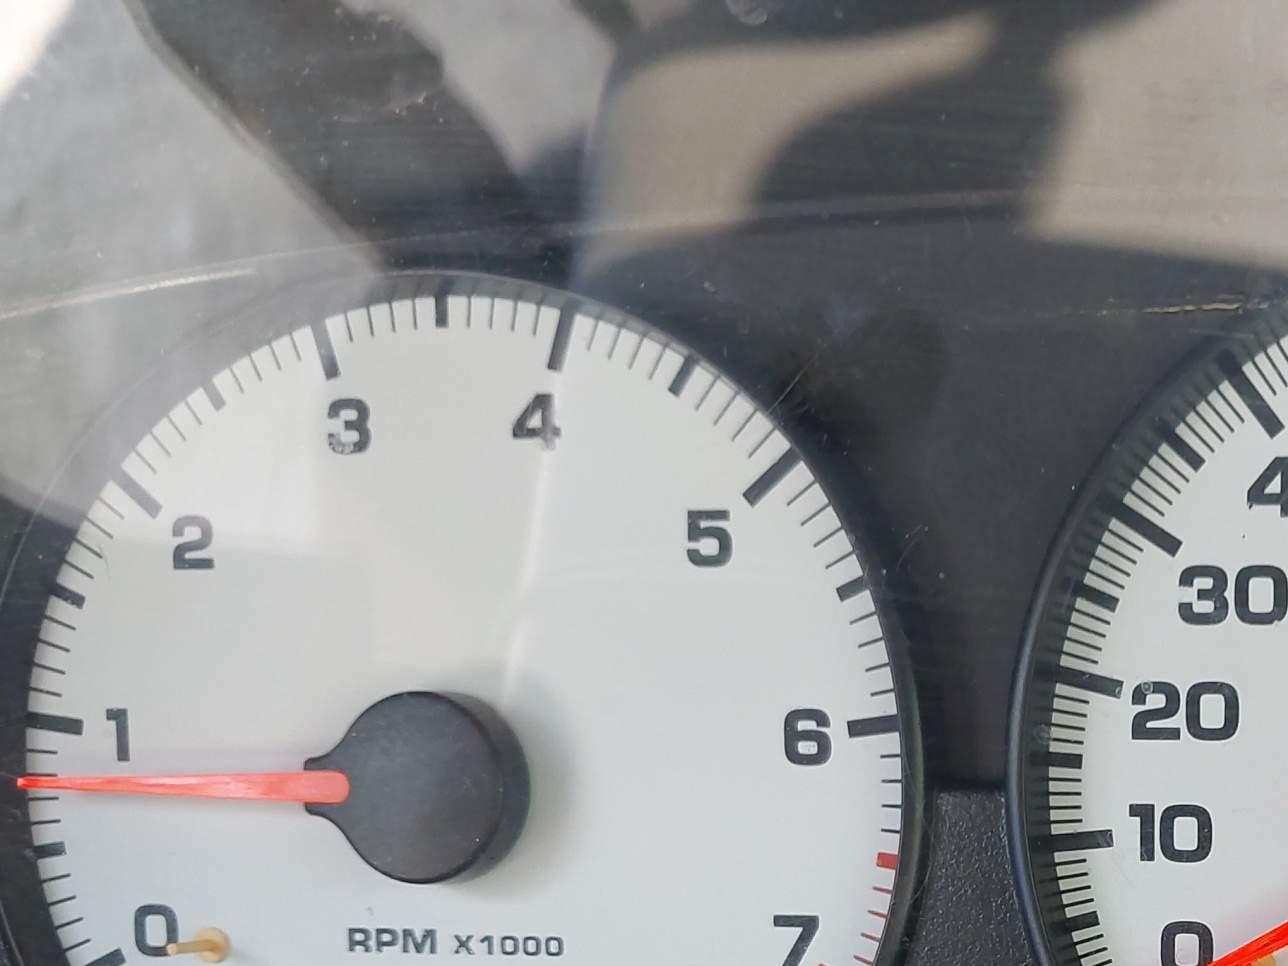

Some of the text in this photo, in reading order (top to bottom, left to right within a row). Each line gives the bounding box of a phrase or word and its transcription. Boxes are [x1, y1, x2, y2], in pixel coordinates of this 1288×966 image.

[327, 397, 371, 455] 3
[511, 392, 562, 451] 4
[171, 514, 216, 571] 2
[685, 509, 734, 569] 5
[105, 708, 130, 763] 1
[783, 708, 831, 767] 6
[1130, 680, 1240, 742] 20
[1128, 802, 1214, 864] 10
[133, 903, 180, 958] 0
[347, 927, 438, 956] RPM
